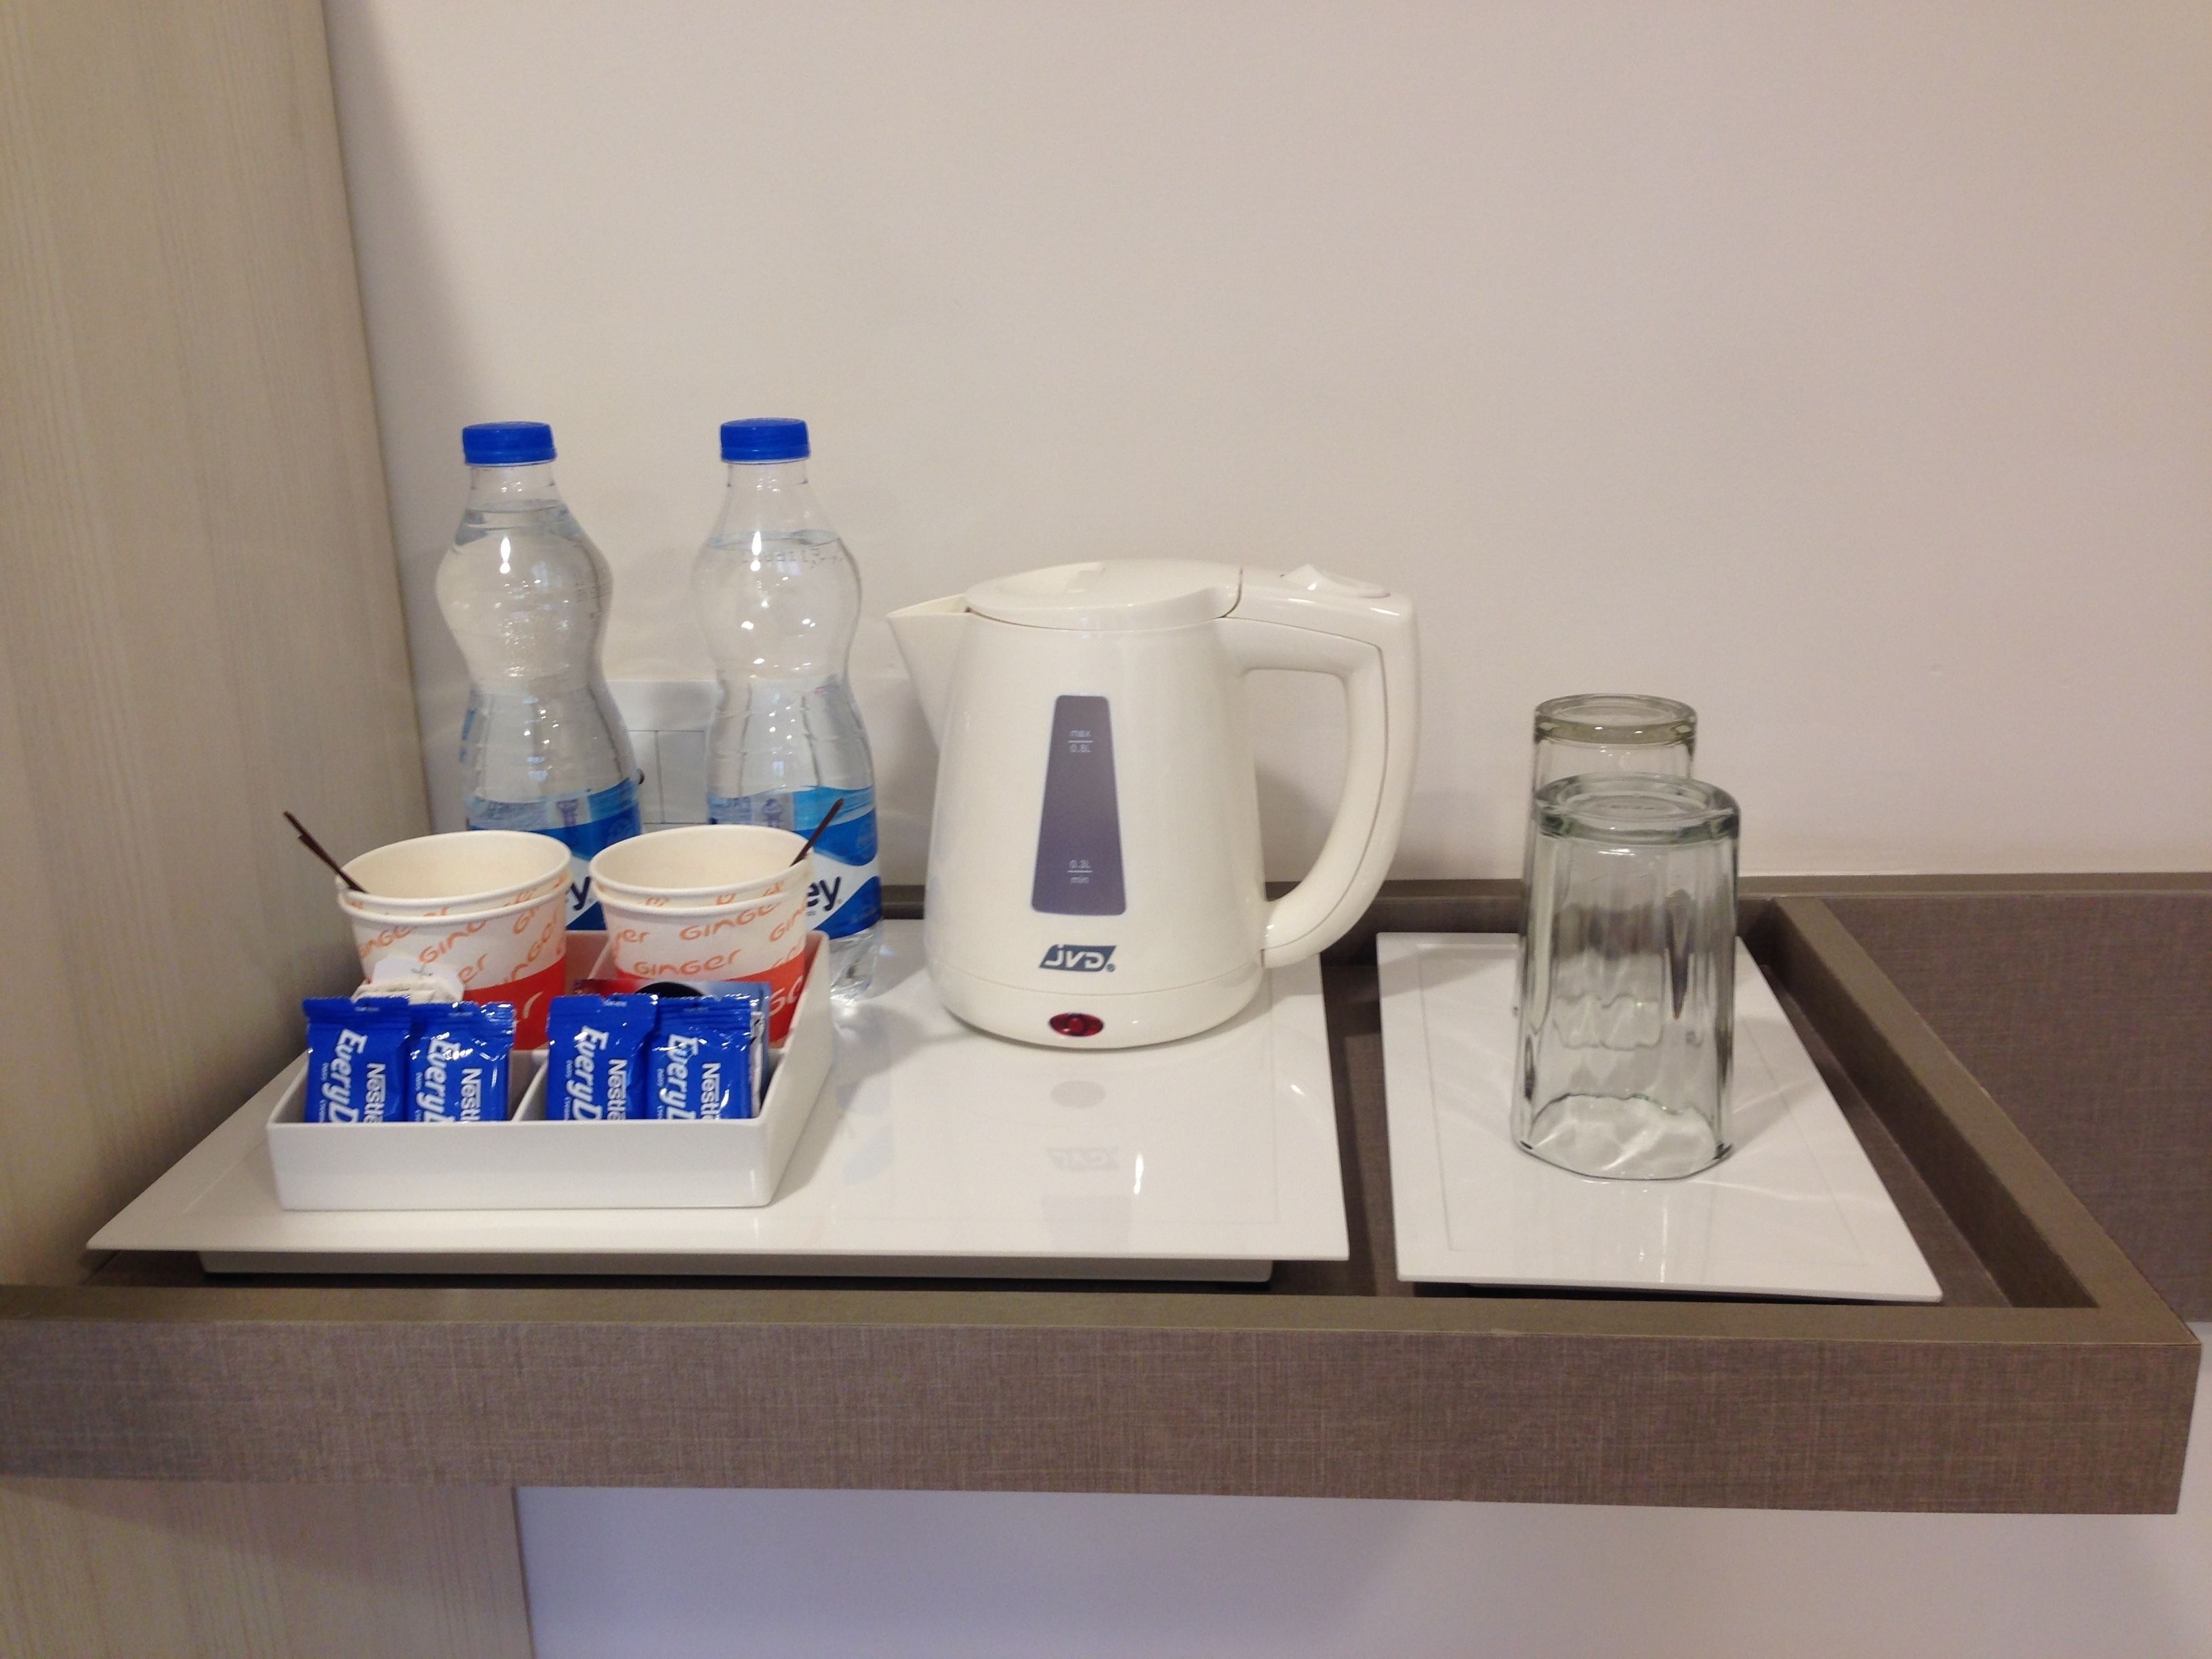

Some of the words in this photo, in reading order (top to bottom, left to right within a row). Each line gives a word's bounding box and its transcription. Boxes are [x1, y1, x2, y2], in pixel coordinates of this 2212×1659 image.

[1069, 730, 1091, 738] max
[1069, 876, 1090, 884] min
[321, 1028, 369, 1122] EveryD
[565, 1025, 610, 1120] EveryD
